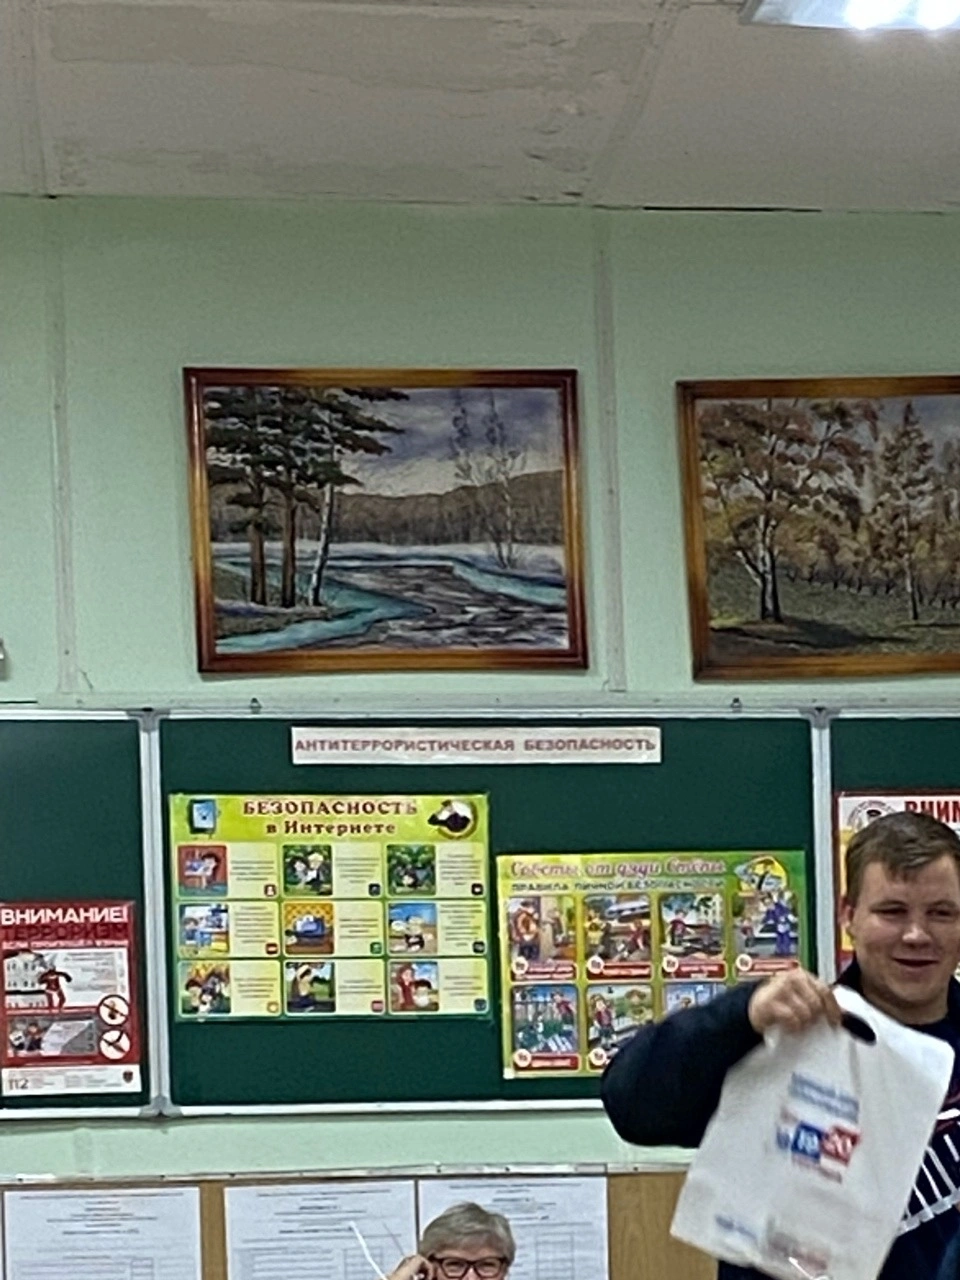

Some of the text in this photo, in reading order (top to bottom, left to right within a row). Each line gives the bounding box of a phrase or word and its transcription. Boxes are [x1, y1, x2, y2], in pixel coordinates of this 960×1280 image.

[294, 738, 657, 752] АНТИТЕРРОРИСТИЧЕСКАЯ БЕЗОПАСНОСТЬ
[242, 800, 418, 815] БЕЗОПАСНОСТЬ
[266, 820, 396, 836] в Интернете
[1, 906, 128, 925] ВНИМАНИЕ!
[1, 922, 129, 941] ТЕРРОРИЗМ
